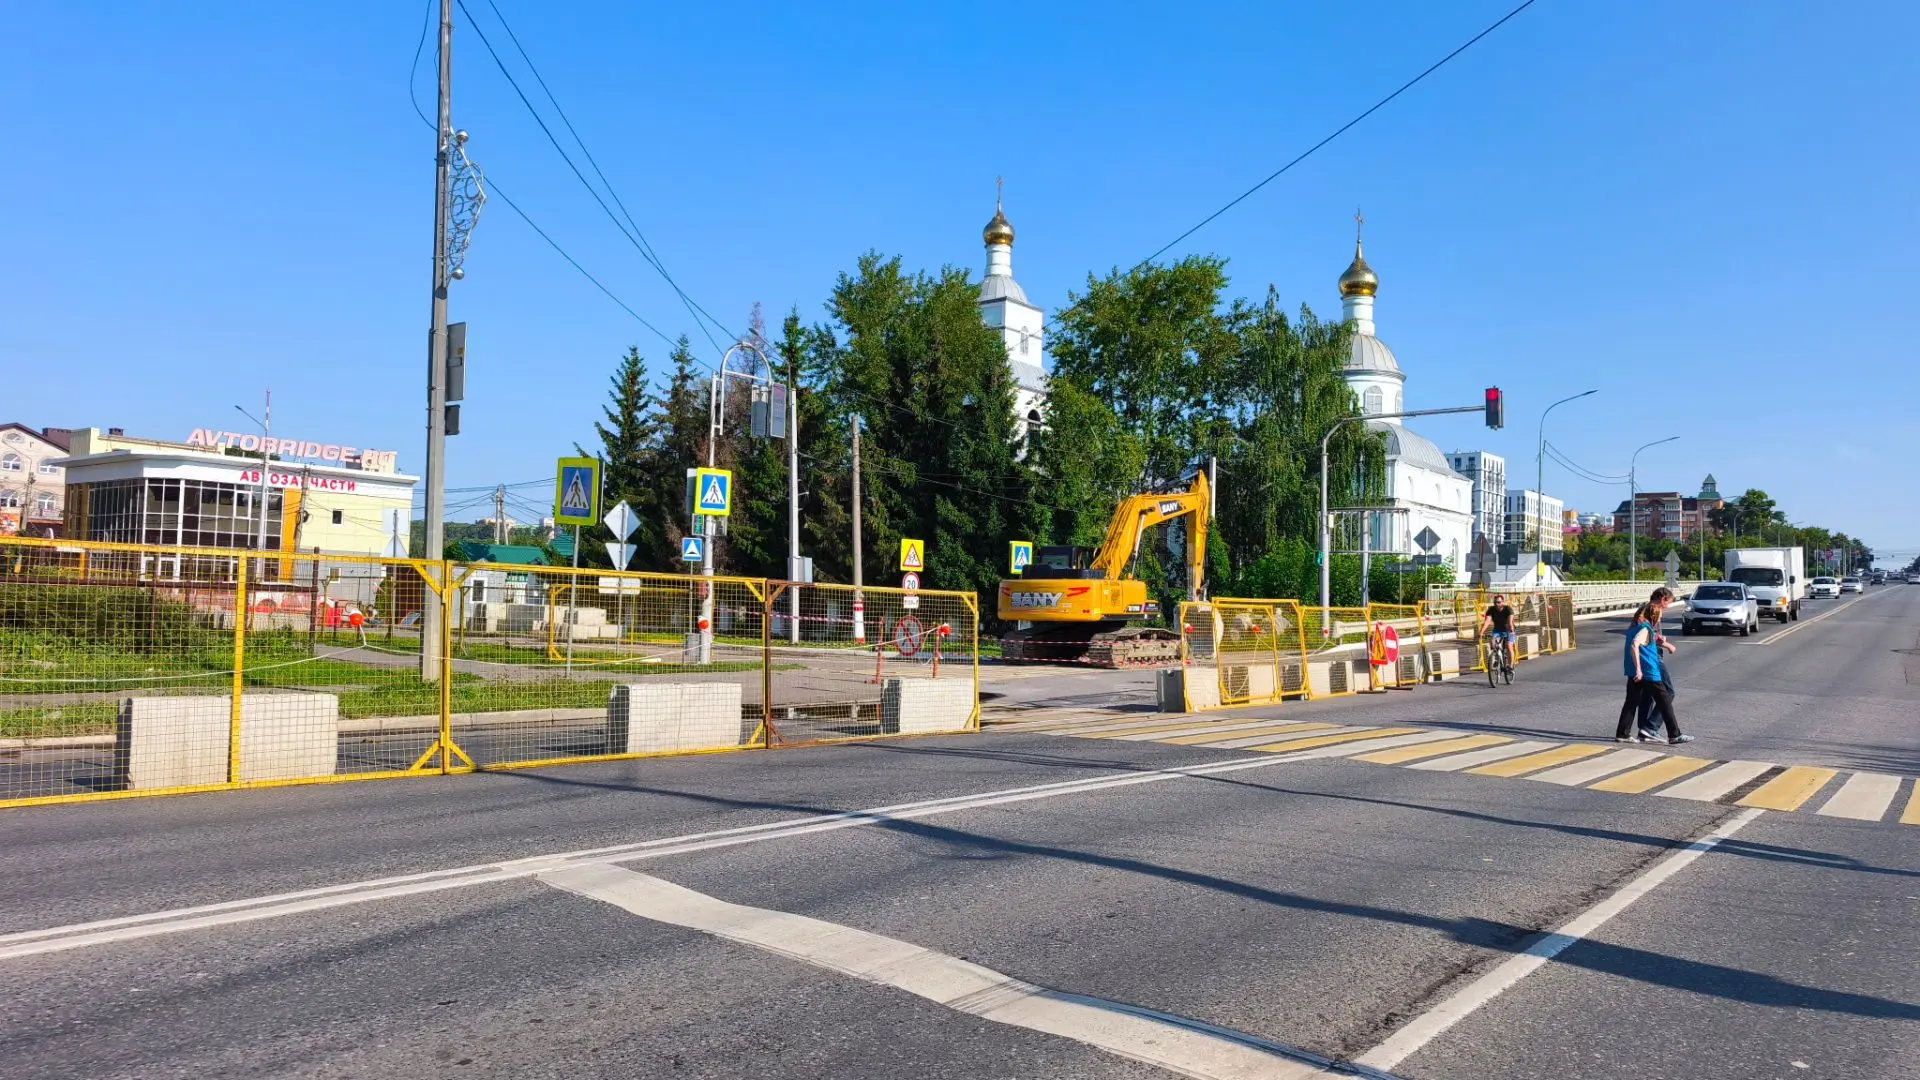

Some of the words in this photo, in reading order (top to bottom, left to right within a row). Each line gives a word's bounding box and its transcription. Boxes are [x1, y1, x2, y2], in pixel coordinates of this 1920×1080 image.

[240, 470, 356, 492] АВОЗАЧАСТИ
[1161, 502, 1178, 513] SANY
[906, 579, 916, 589] 20
[1011, 592, 1063, 608] SANY
